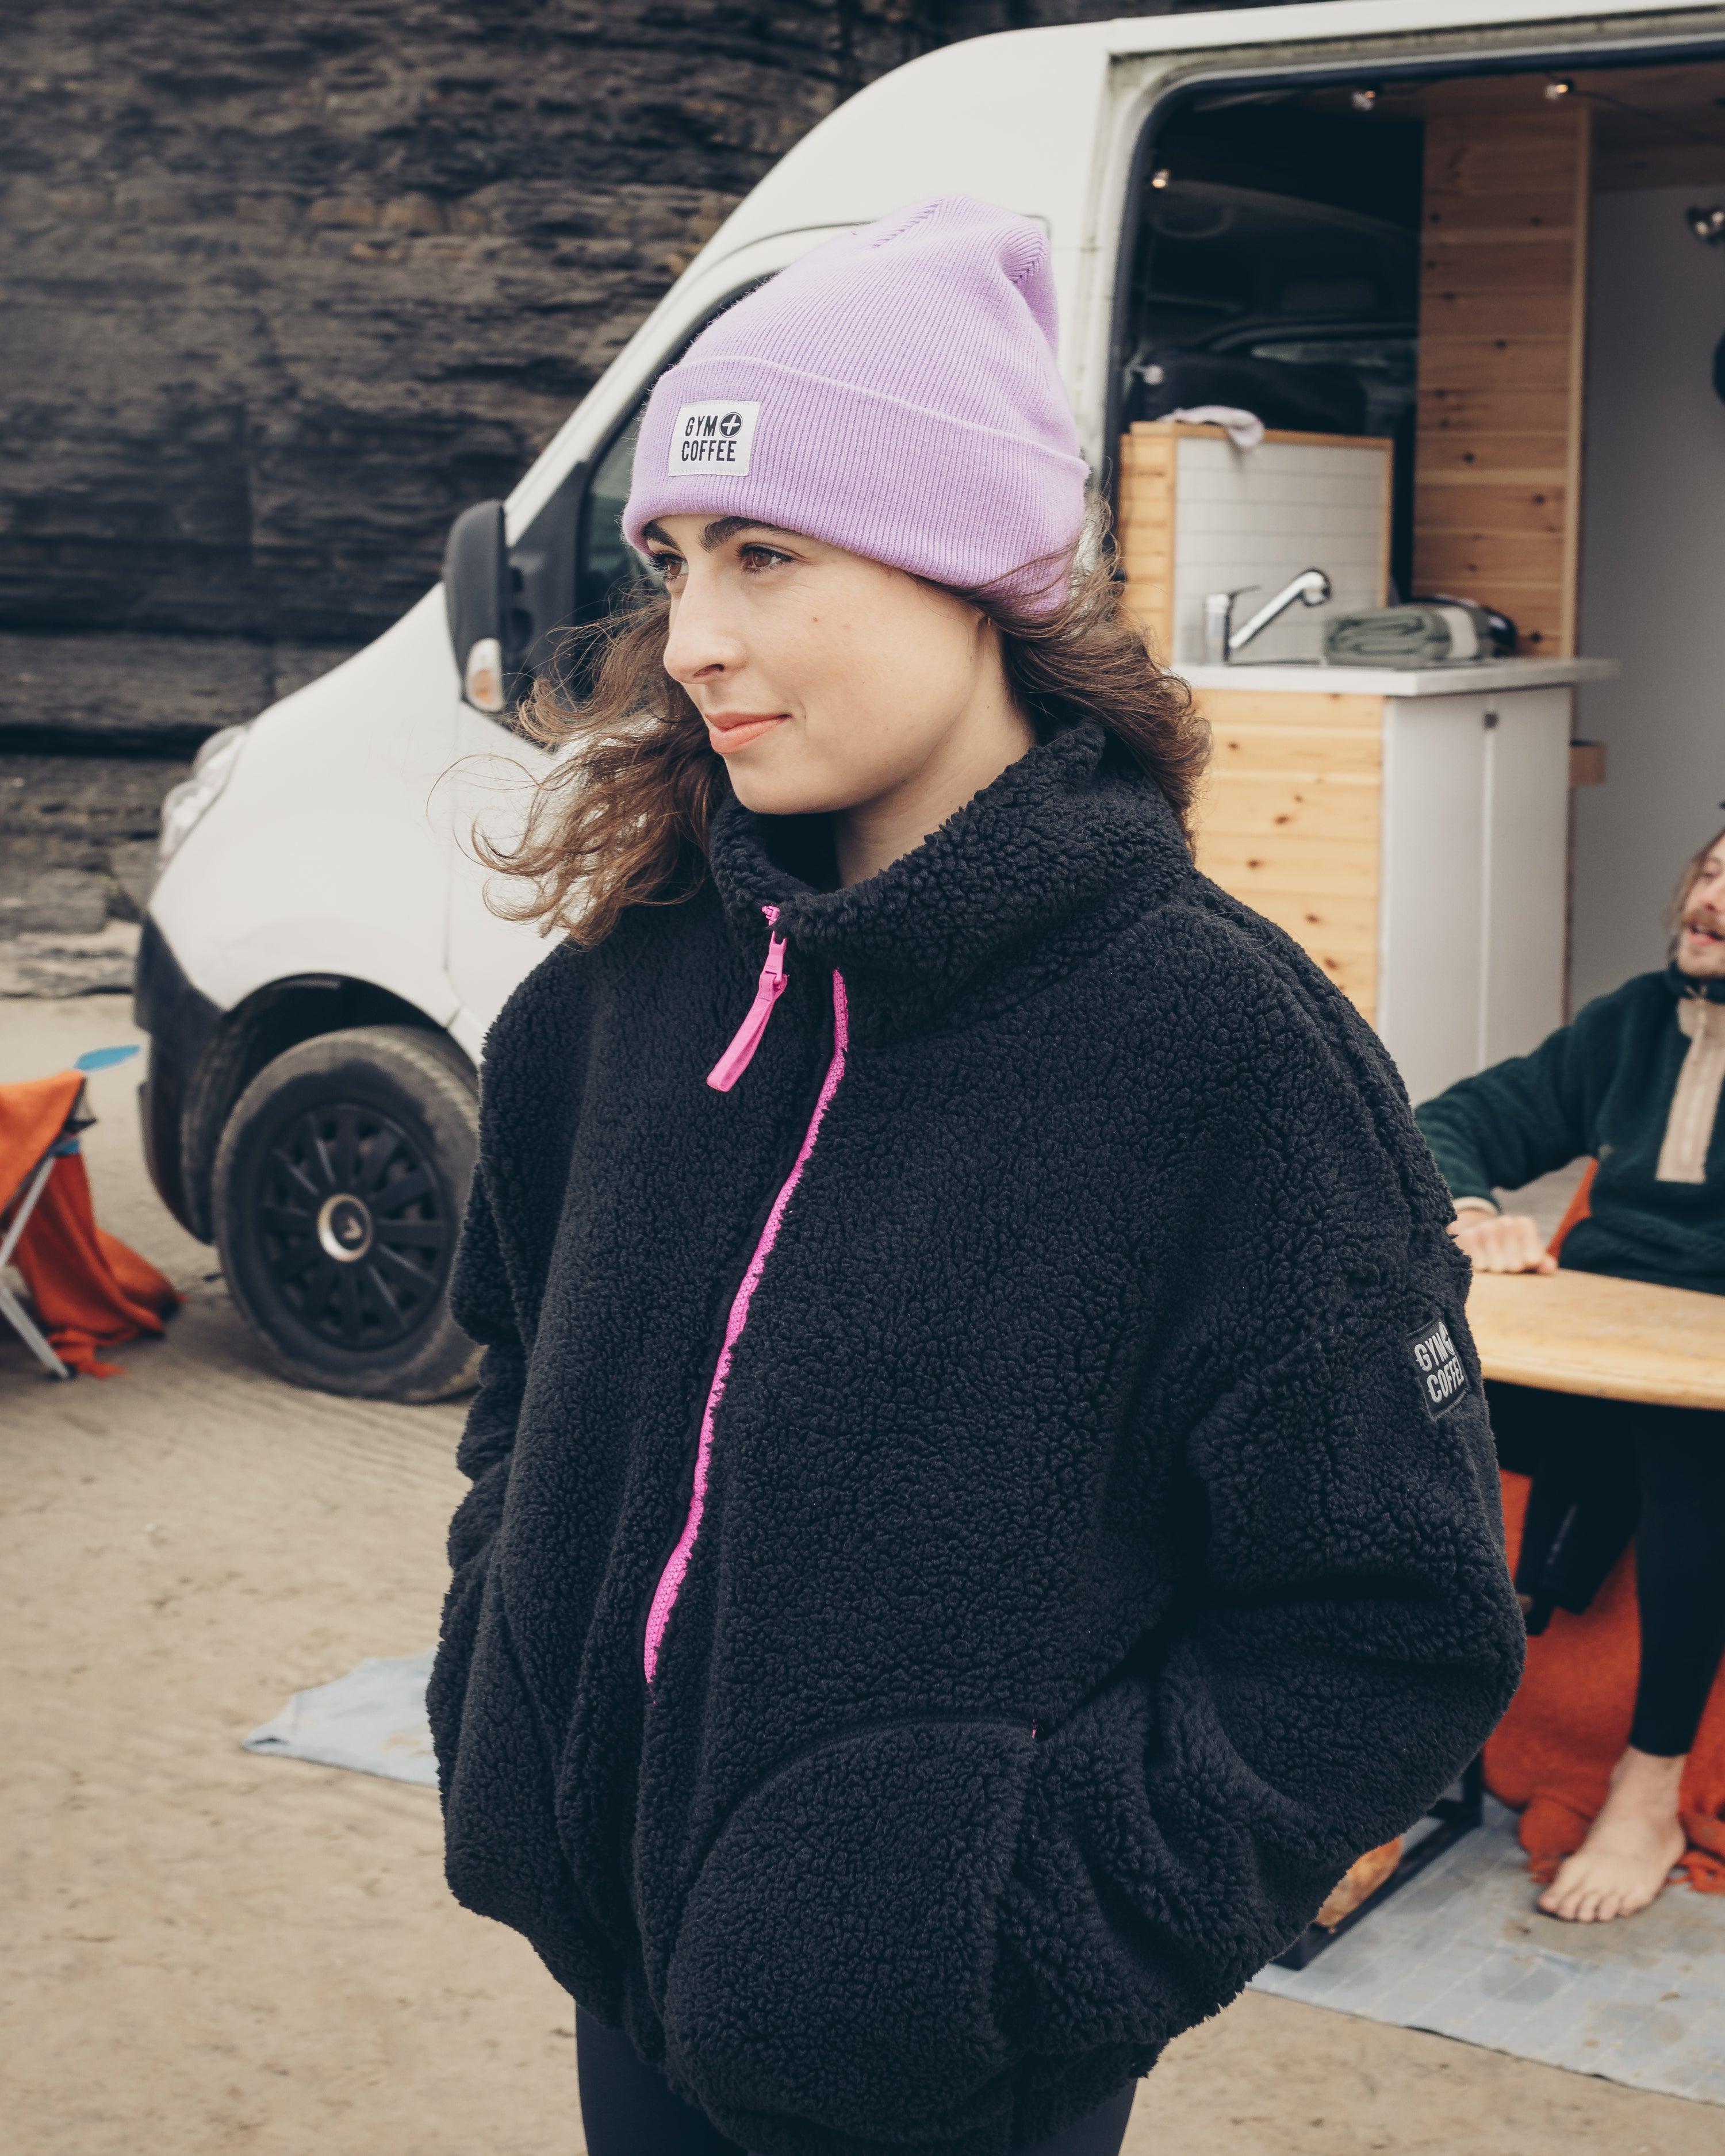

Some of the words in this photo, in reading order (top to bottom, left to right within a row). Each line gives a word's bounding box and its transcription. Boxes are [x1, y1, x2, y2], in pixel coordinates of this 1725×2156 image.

[685, 416, 718, 436] GYM
[681, 440, 737, 461] COFFEE
[1414, 1333, 1448, 1371] GYM
